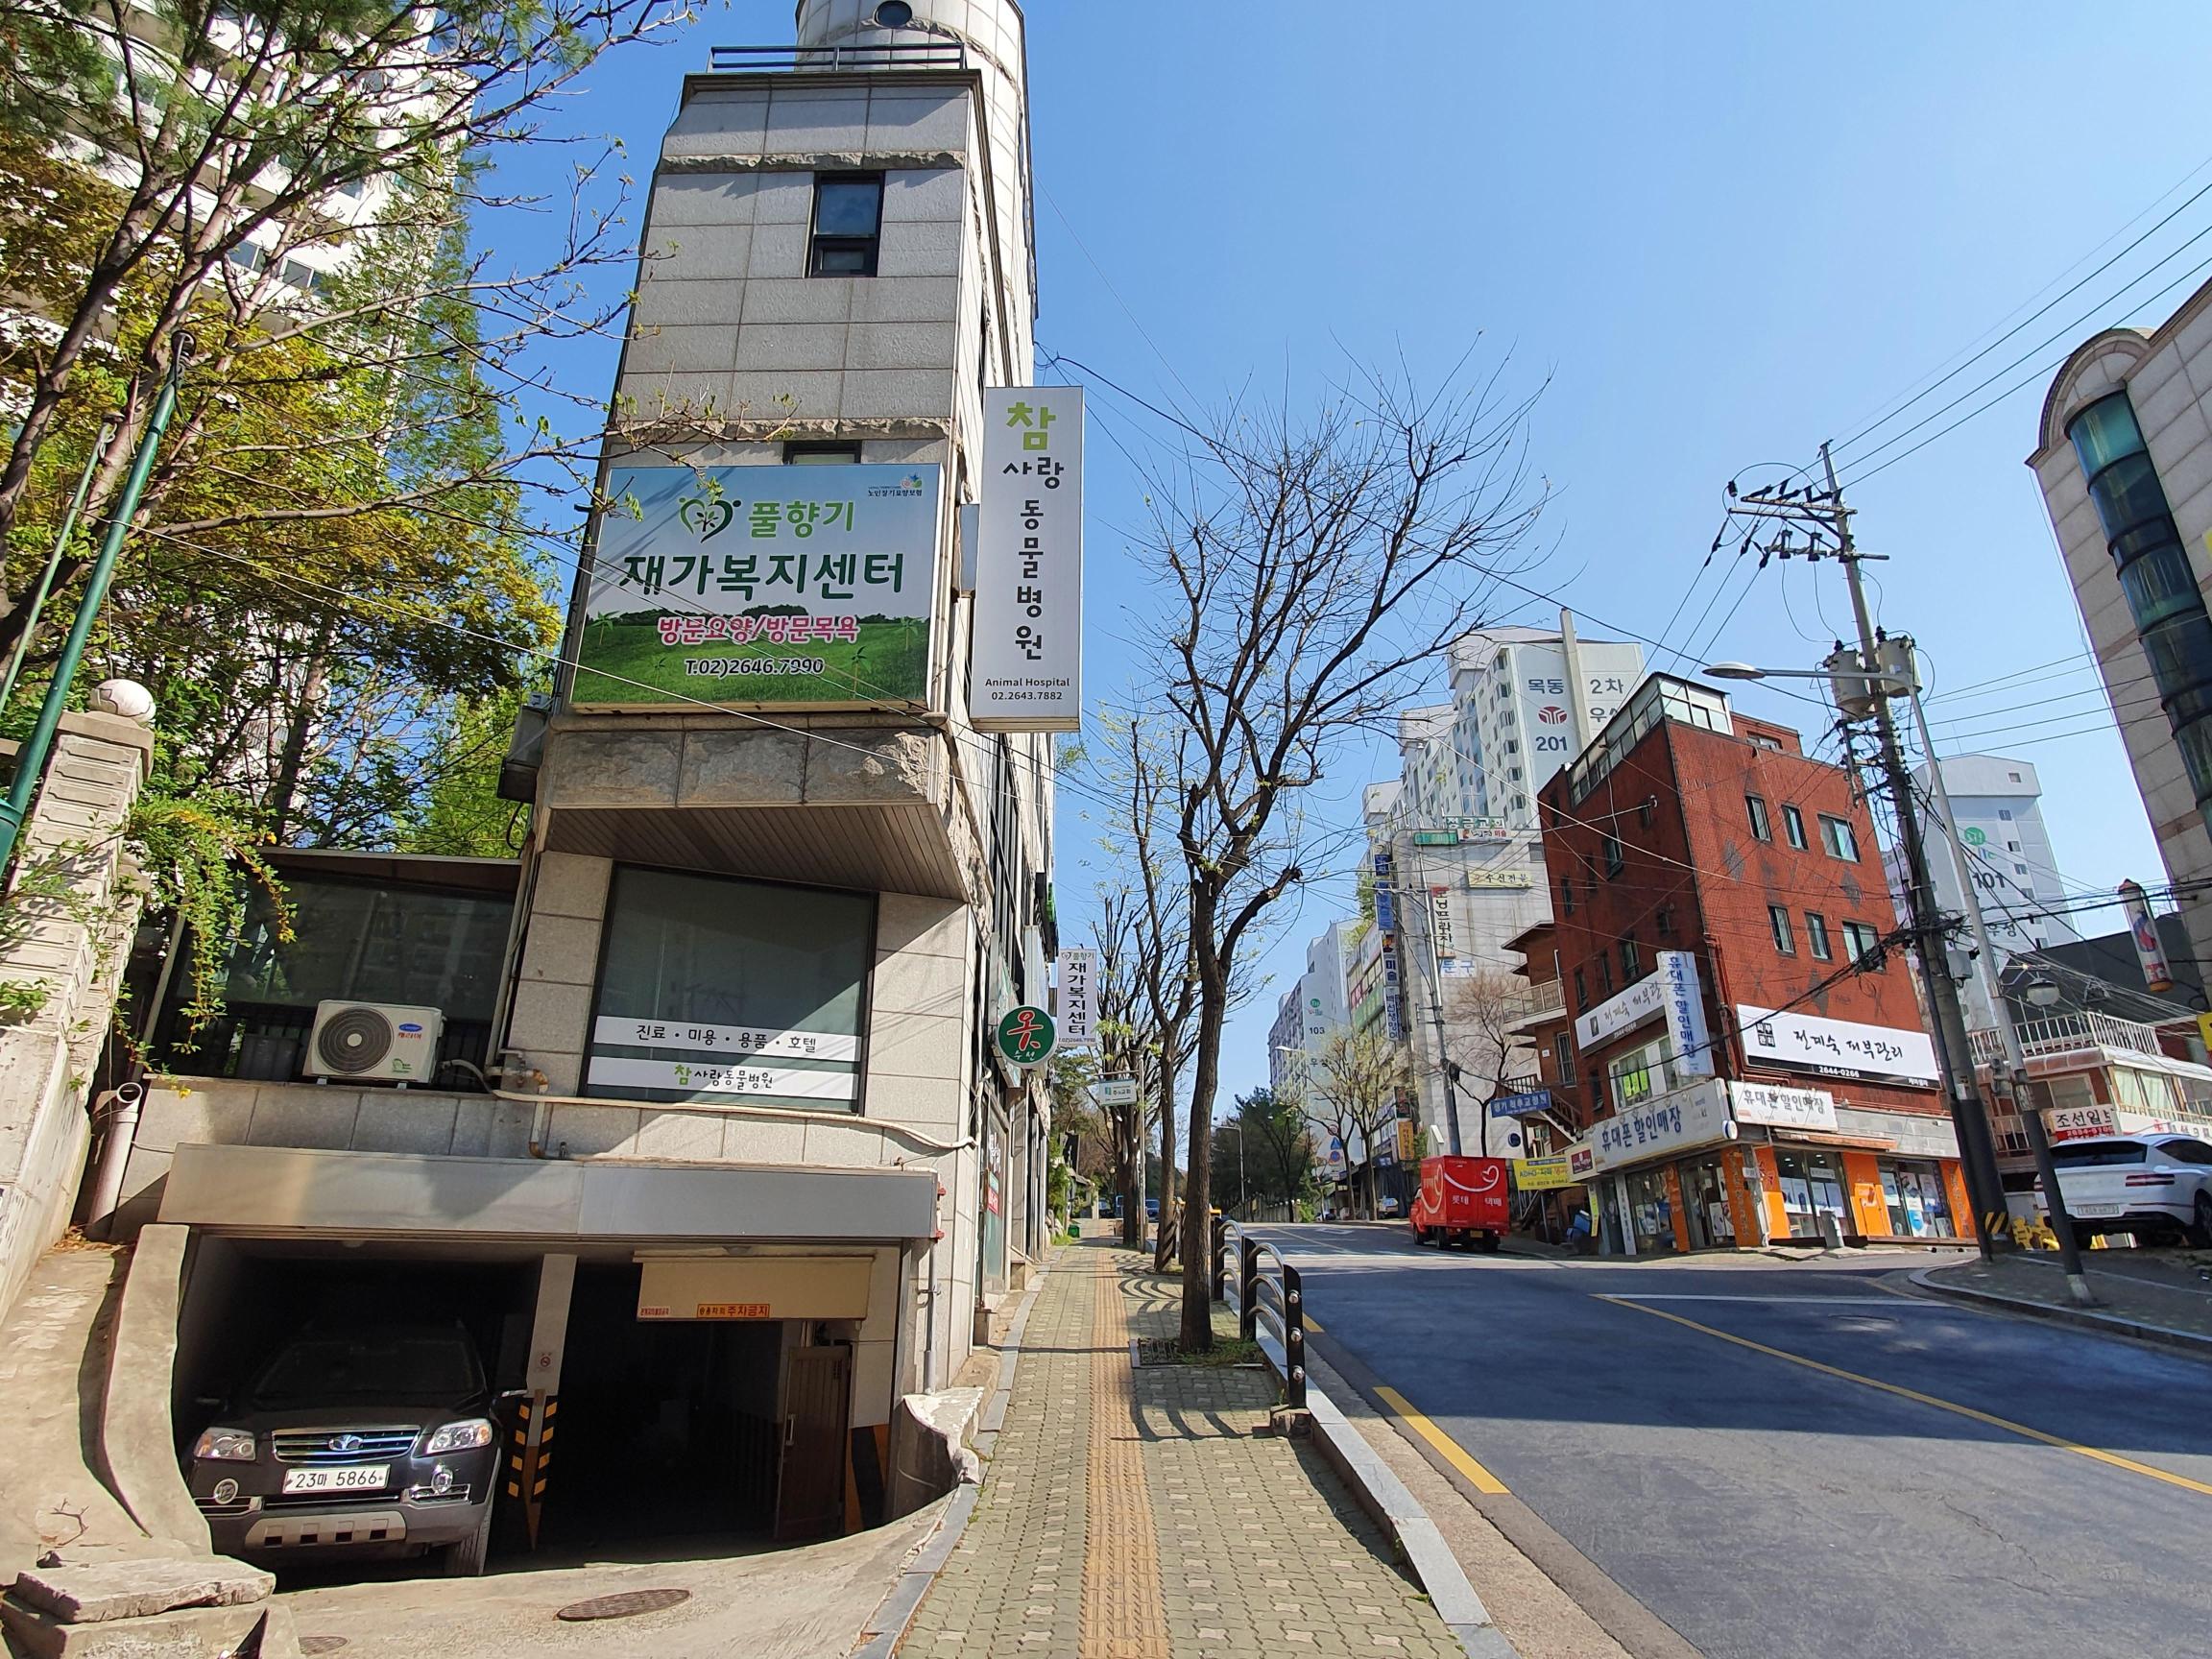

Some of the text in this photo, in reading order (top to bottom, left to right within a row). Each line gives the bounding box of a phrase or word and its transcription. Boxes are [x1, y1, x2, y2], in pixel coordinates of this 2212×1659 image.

[1006, 401, 1057, 450] 참
[1002, 457, 1065, 490] 사랑
[749, 500, 854, 539] 풀향기
[619, 552, 904, 601] 재가복지센터
[1015, 499, 1044, 661] 동물병원
[659, 615, 860, 645] 방문요양/방문목욕
[985, 678, 1070, 688] Animal Hospital
[1528, 678, 1624, 694] 목동 2차
[991, 691, 1063, 701] 02.2643.7882
[1590, 707, 1618, 723] 우
[1535, 735, 1568, 752] 201
[1973, 872, 2006, 889] 101
[1068, 962, 1087, 1036] 재가복지센터
[636, 1024, 816, 1053] 진료 미용 용품 호텔
[1006, 1010, 1045, 1051] 옷
[1310, 1026, 1325, 1035] 103
[1818, 1066, 1860, 1078] 2644-0266
[1601, 1125, 1632, 1152] 휴대폰
[1634, 1105, 1681, 1144] 할인매장
[728, 1306, 768, 1316] 주차금지
[295, 1471, 378, 1489] 23마 5866
